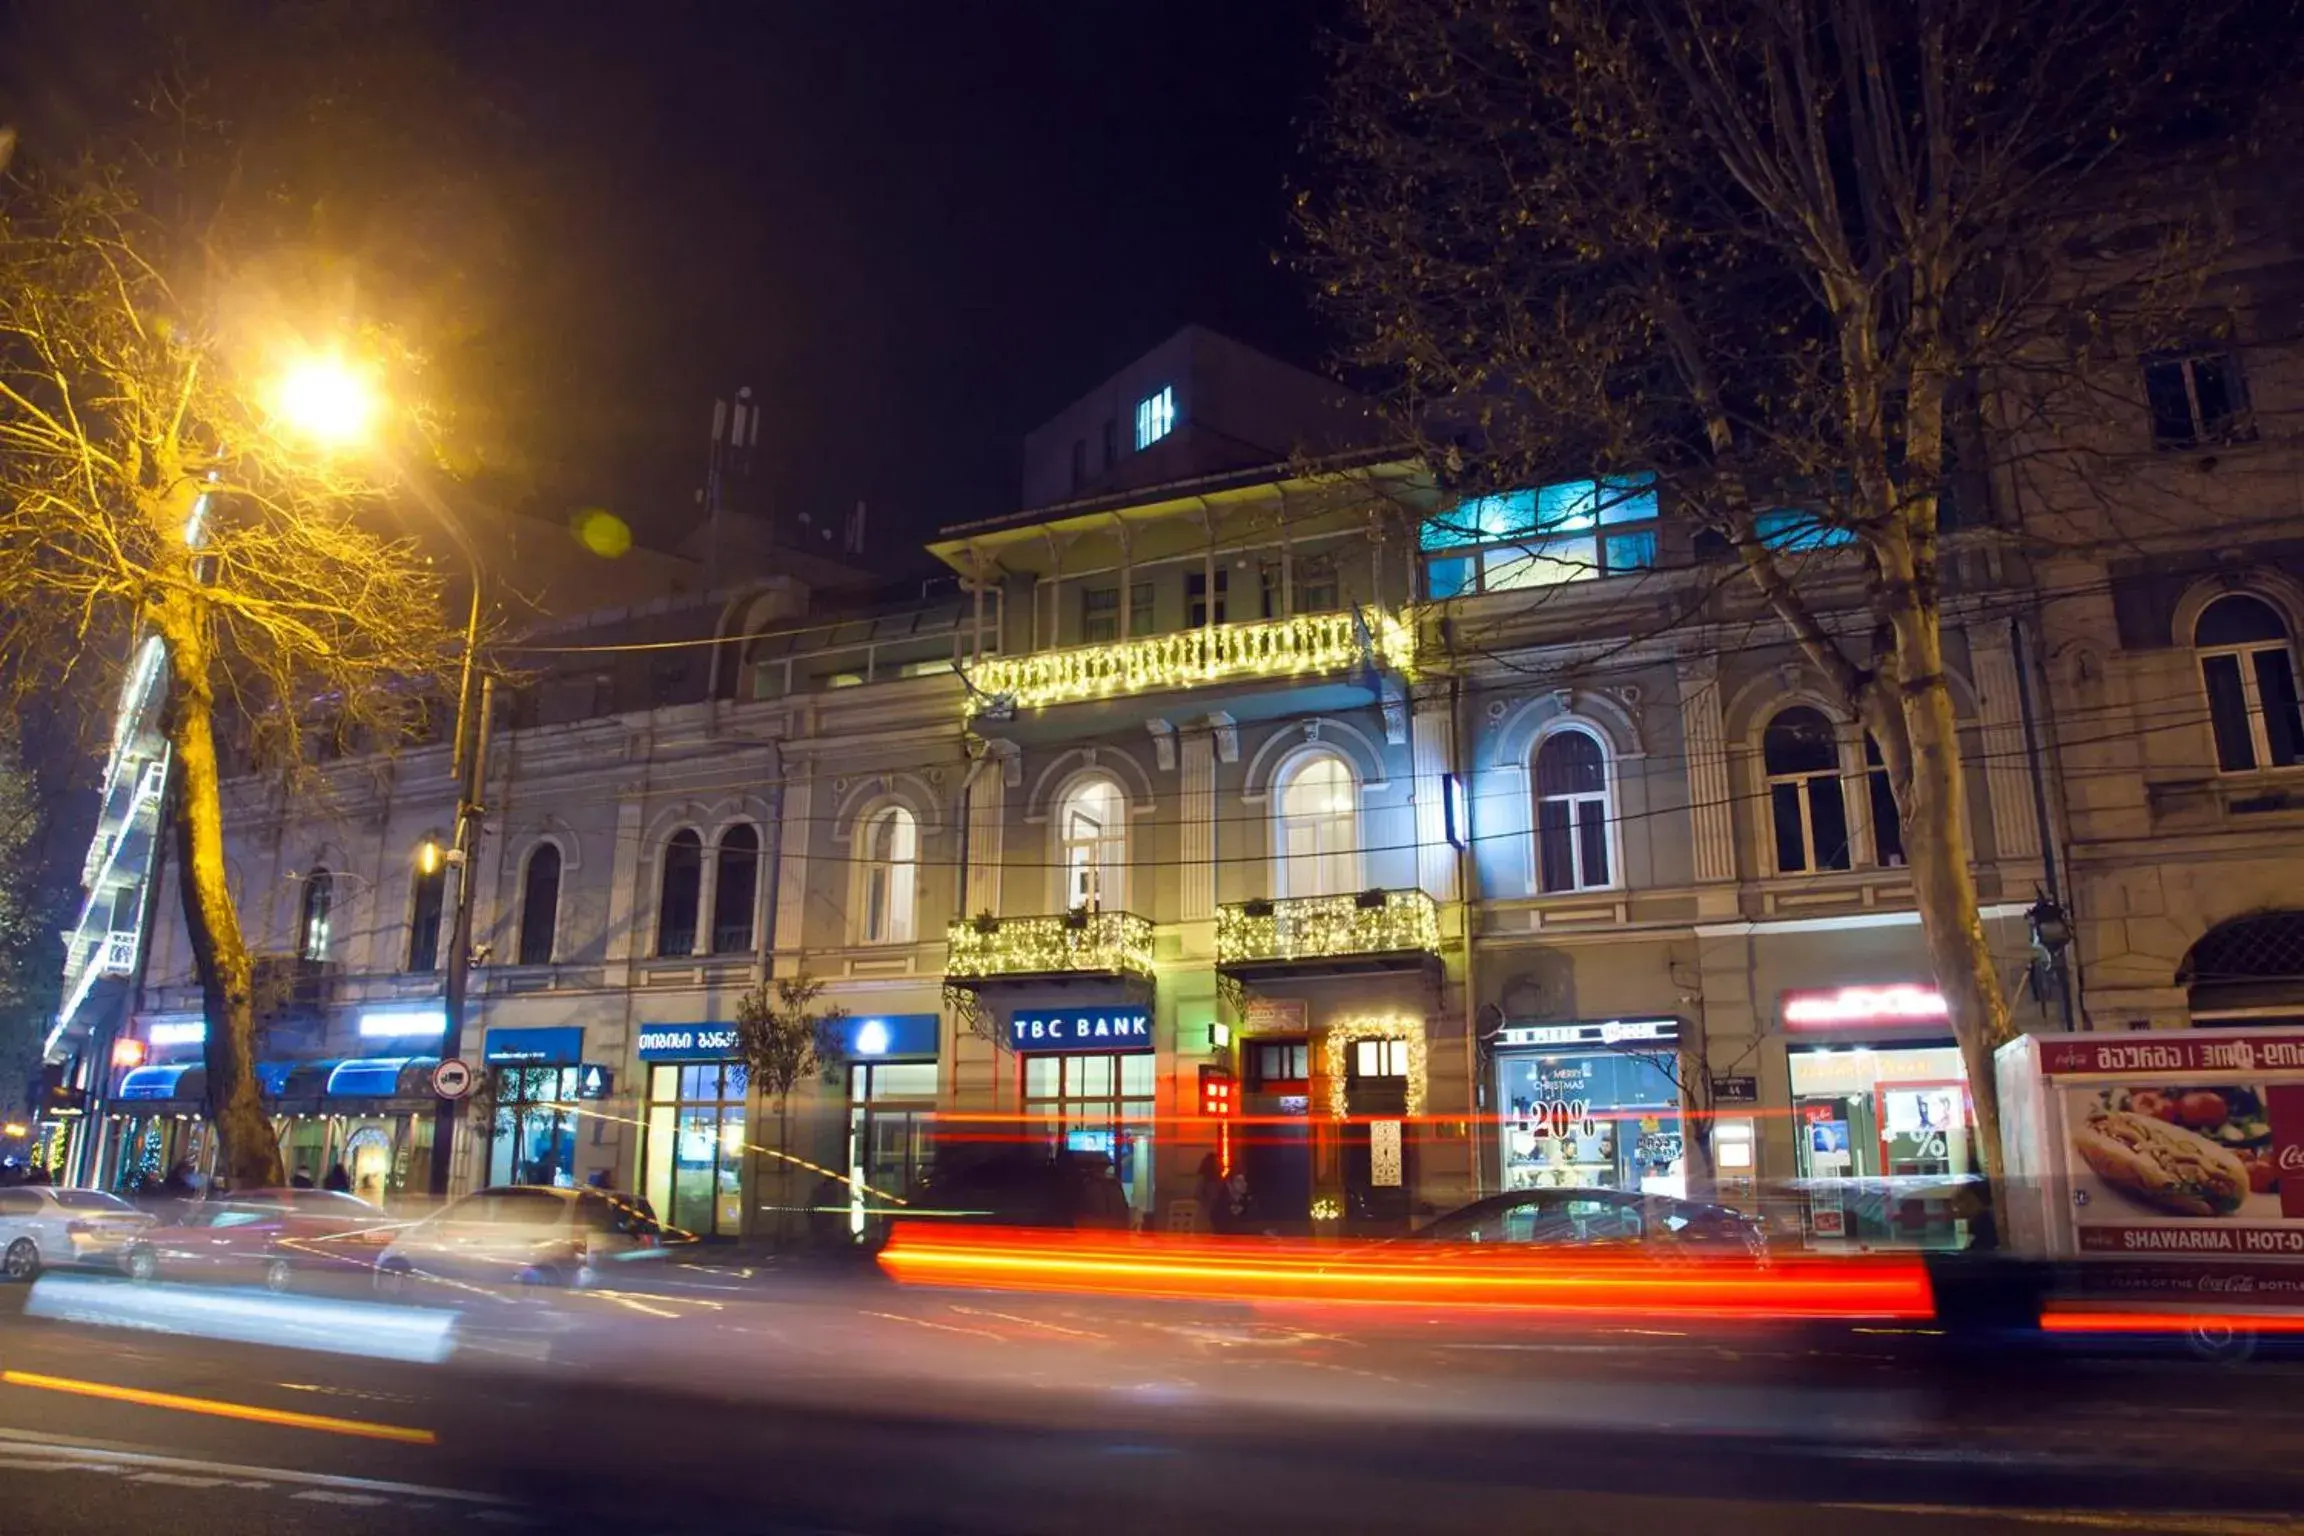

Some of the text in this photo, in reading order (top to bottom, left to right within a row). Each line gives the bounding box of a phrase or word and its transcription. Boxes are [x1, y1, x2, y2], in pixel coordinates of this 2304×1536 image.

[1014, 1016, 1147, 1039] TBC BANK
[639, 1032, 692, 1050] თიბისი
[2123, 1230, 2231, 1249] SHAWARMA
[2170, 1280, 2193, 1289] THE
